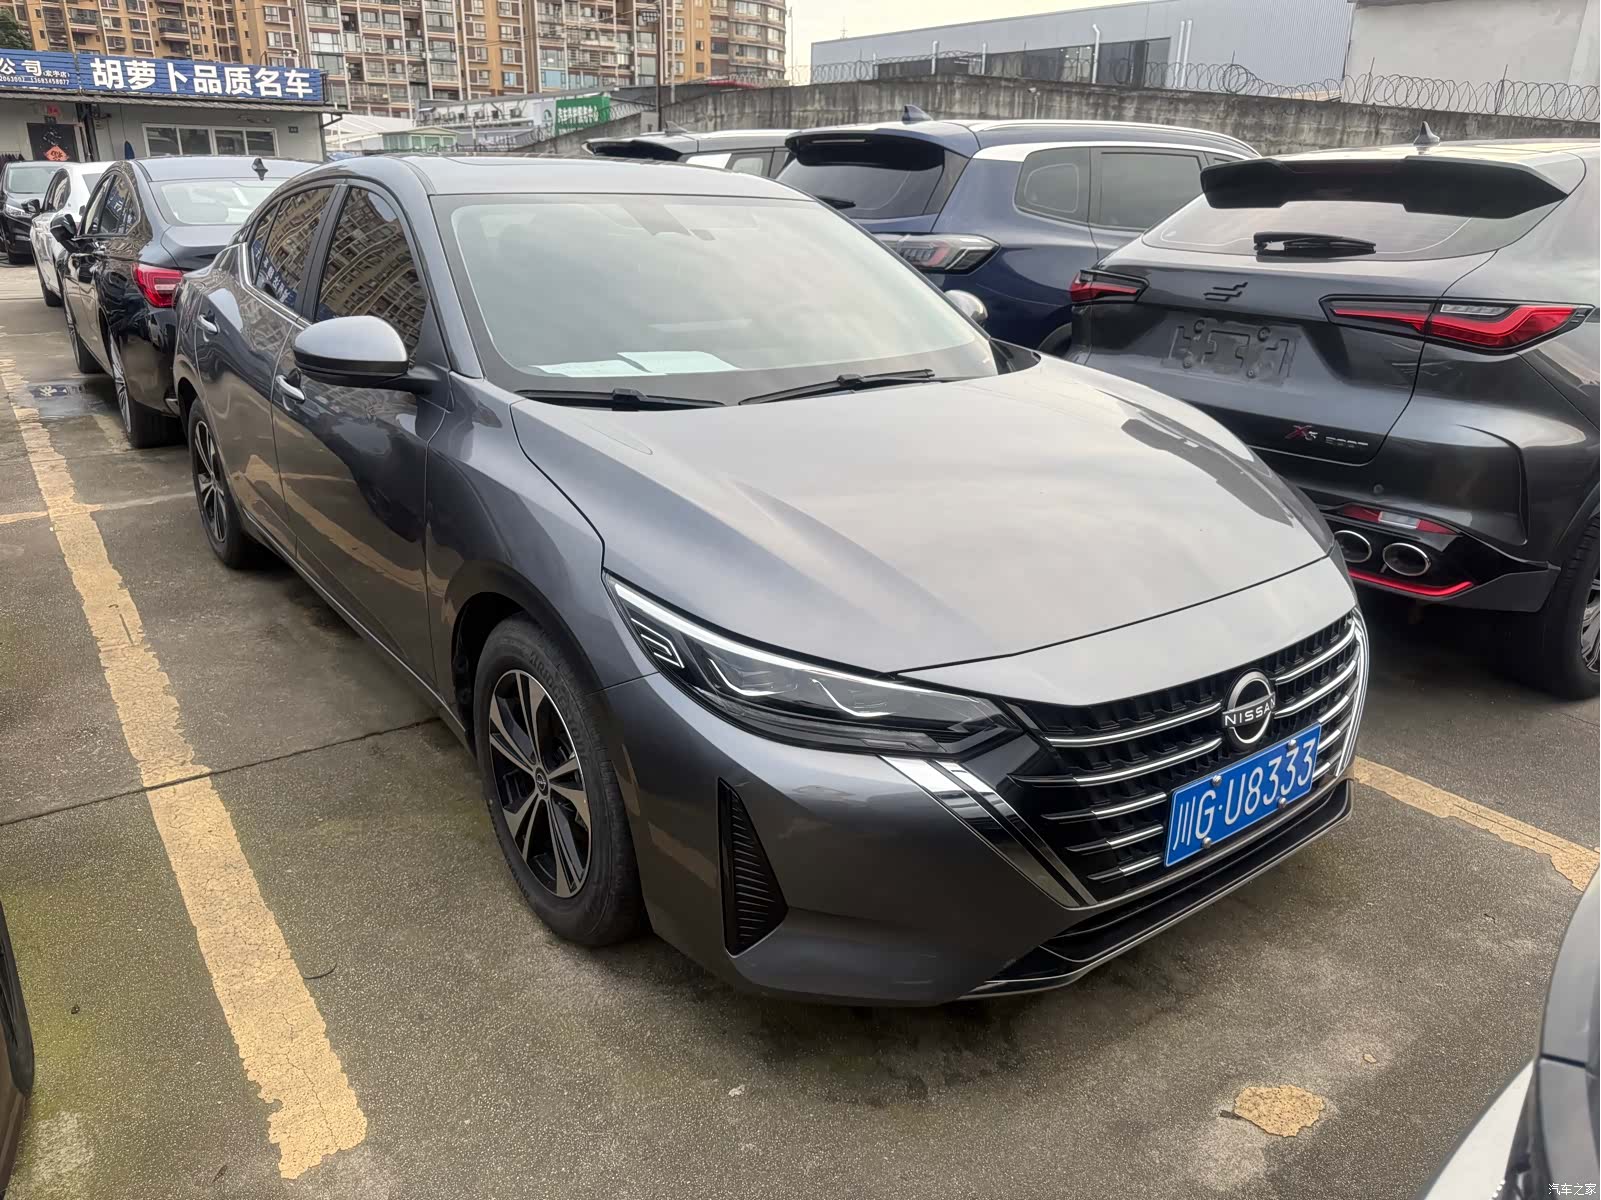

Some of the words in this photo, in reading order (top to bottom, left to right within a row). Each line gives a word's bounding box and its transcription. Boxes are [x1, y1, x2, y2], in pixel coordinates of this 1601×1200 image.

[90, 58, 313, 98] 胡萝卜品质名车
[1224, 695, 1276, 727] NISSAN
